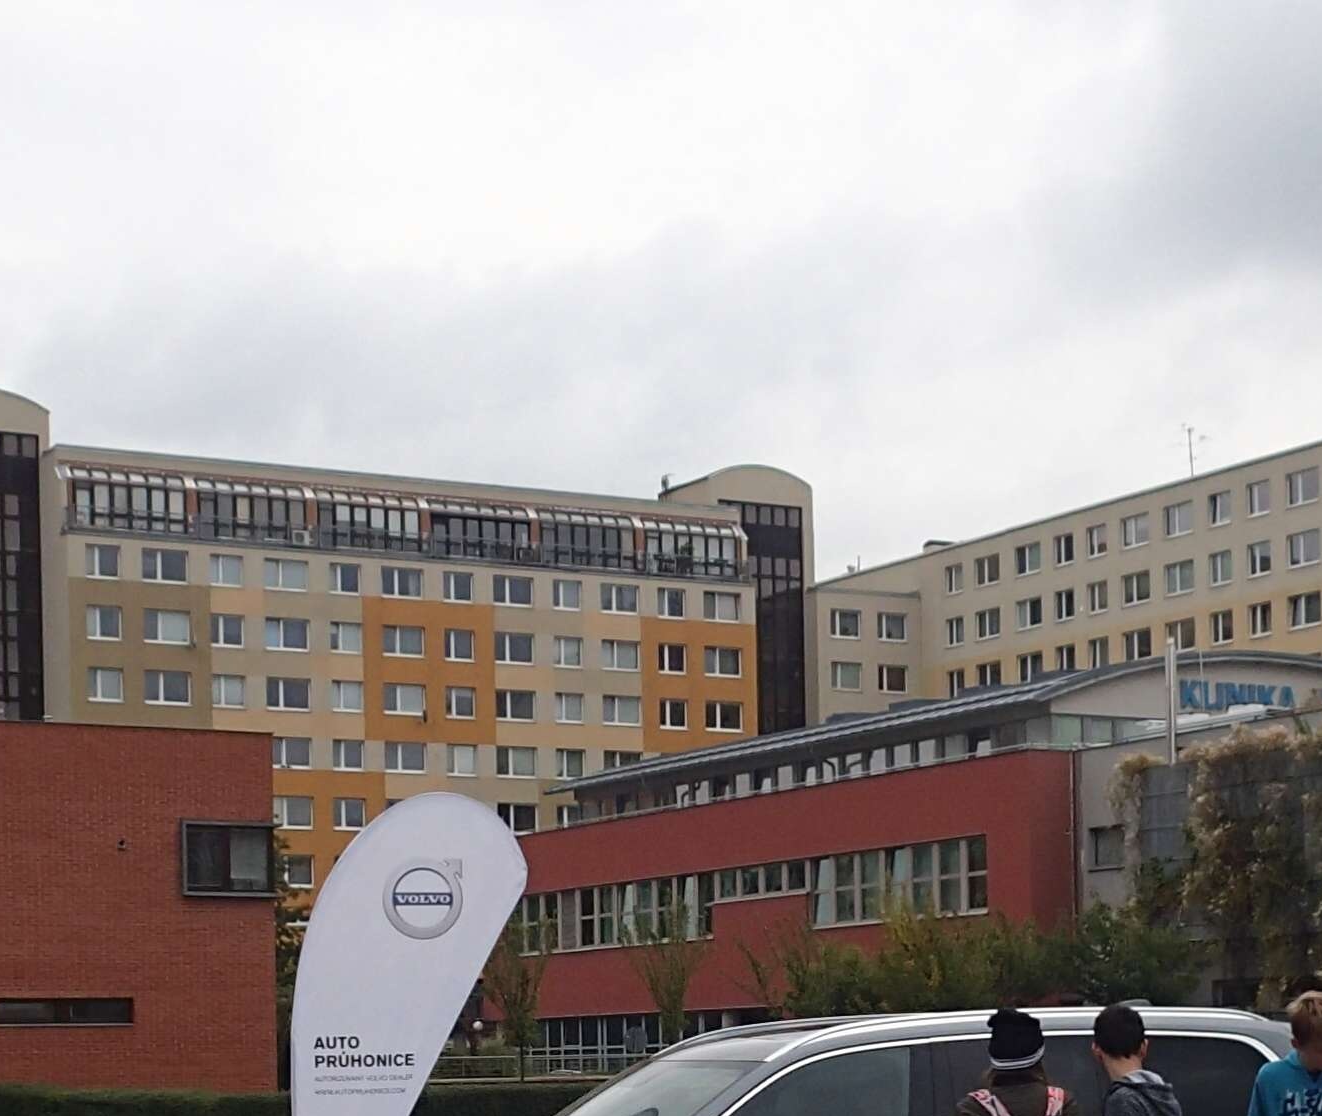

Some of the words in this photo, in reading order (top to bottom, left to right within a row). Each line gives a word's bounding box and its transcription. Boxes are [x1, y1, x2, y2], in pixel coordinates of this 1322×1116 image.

[1179, 678, 1294, 711] KLINIKA
[396, 894, 451, 904] VOLVO
[314, 1035, 360, 1050] AUTO
